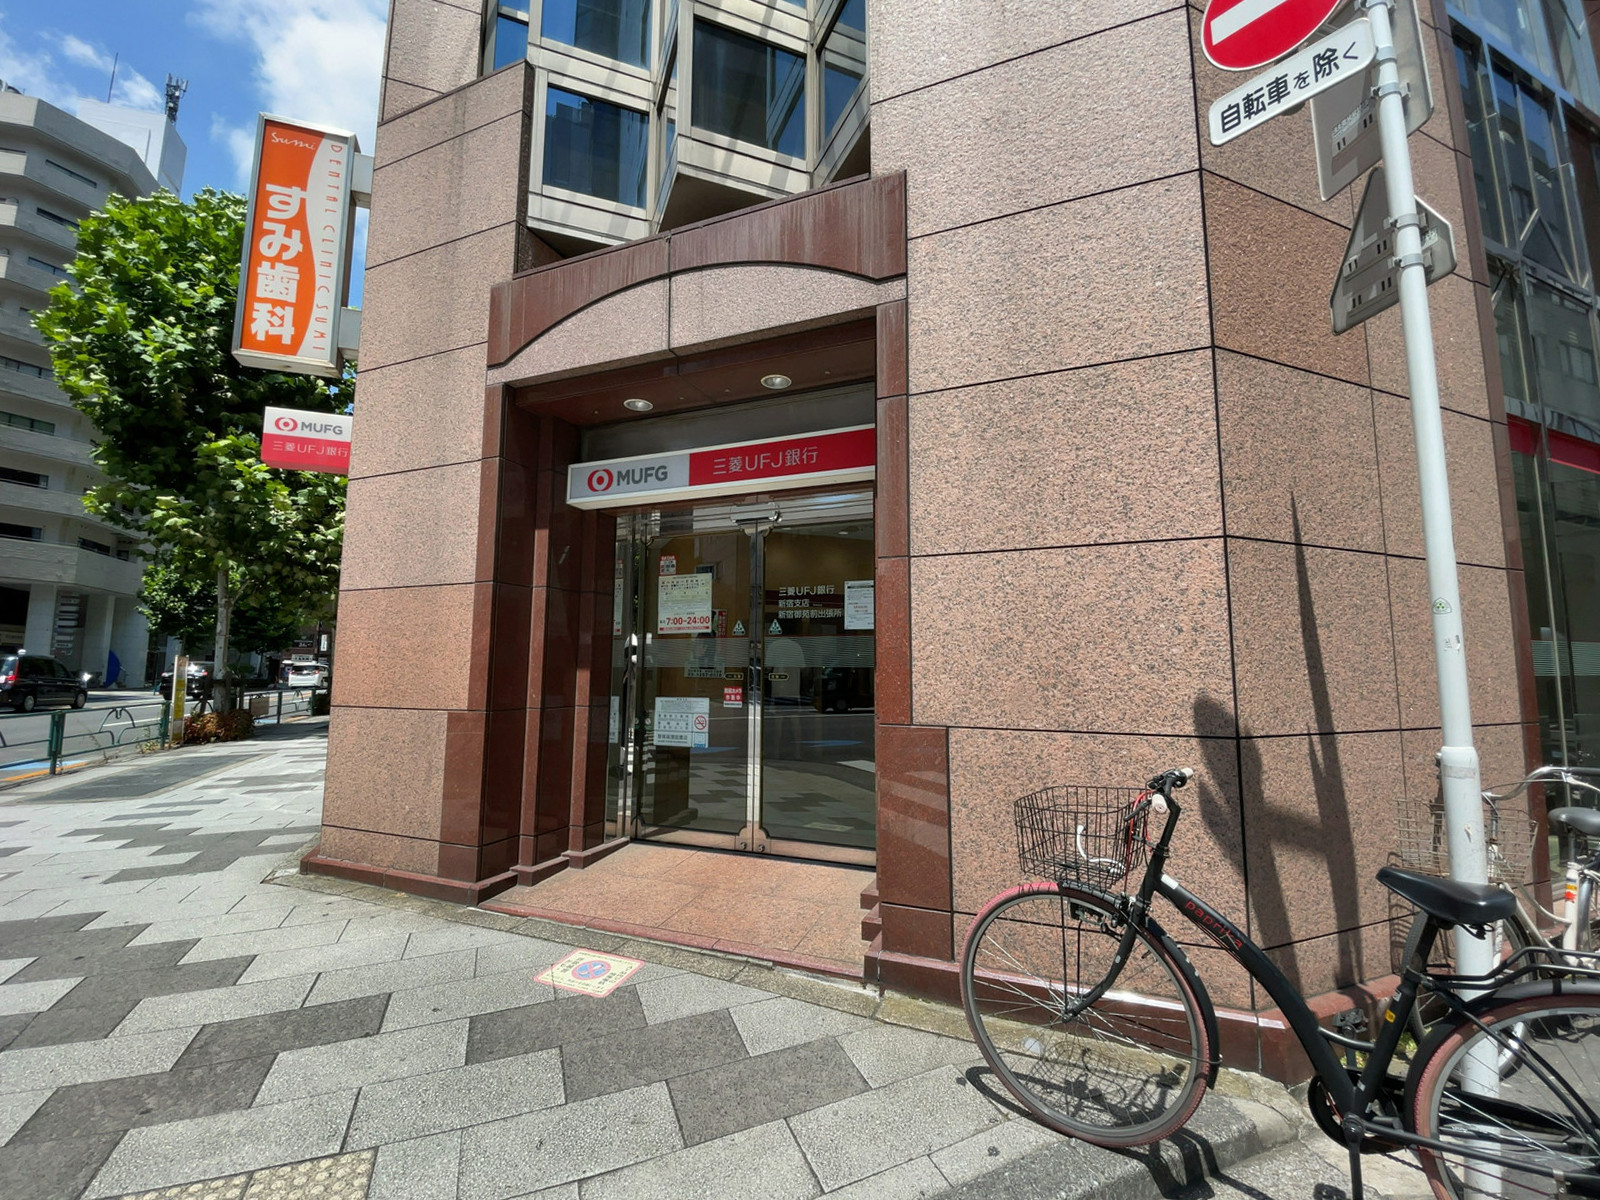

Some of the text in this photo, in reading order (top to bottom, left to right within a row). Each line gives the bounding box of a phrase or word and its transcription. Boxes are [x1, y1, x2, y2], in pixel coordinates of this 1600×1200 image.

[1220, 41, 1359, 134] 自転車を除く
[312, 144, 343, 351] DENTAL CLINIC SUMI
[250, 183, 307, 346] すみ歯科
[300, 421, 343, 435] MUFG
[272, 440, 349, 458] 三菱UFJ銀行
[712, 446, 819, 475] 三菱UFJ銀行
[616, 464, 668, 487] MUFG
[778, 585, 835, 597] 三菱UFJ銀行
